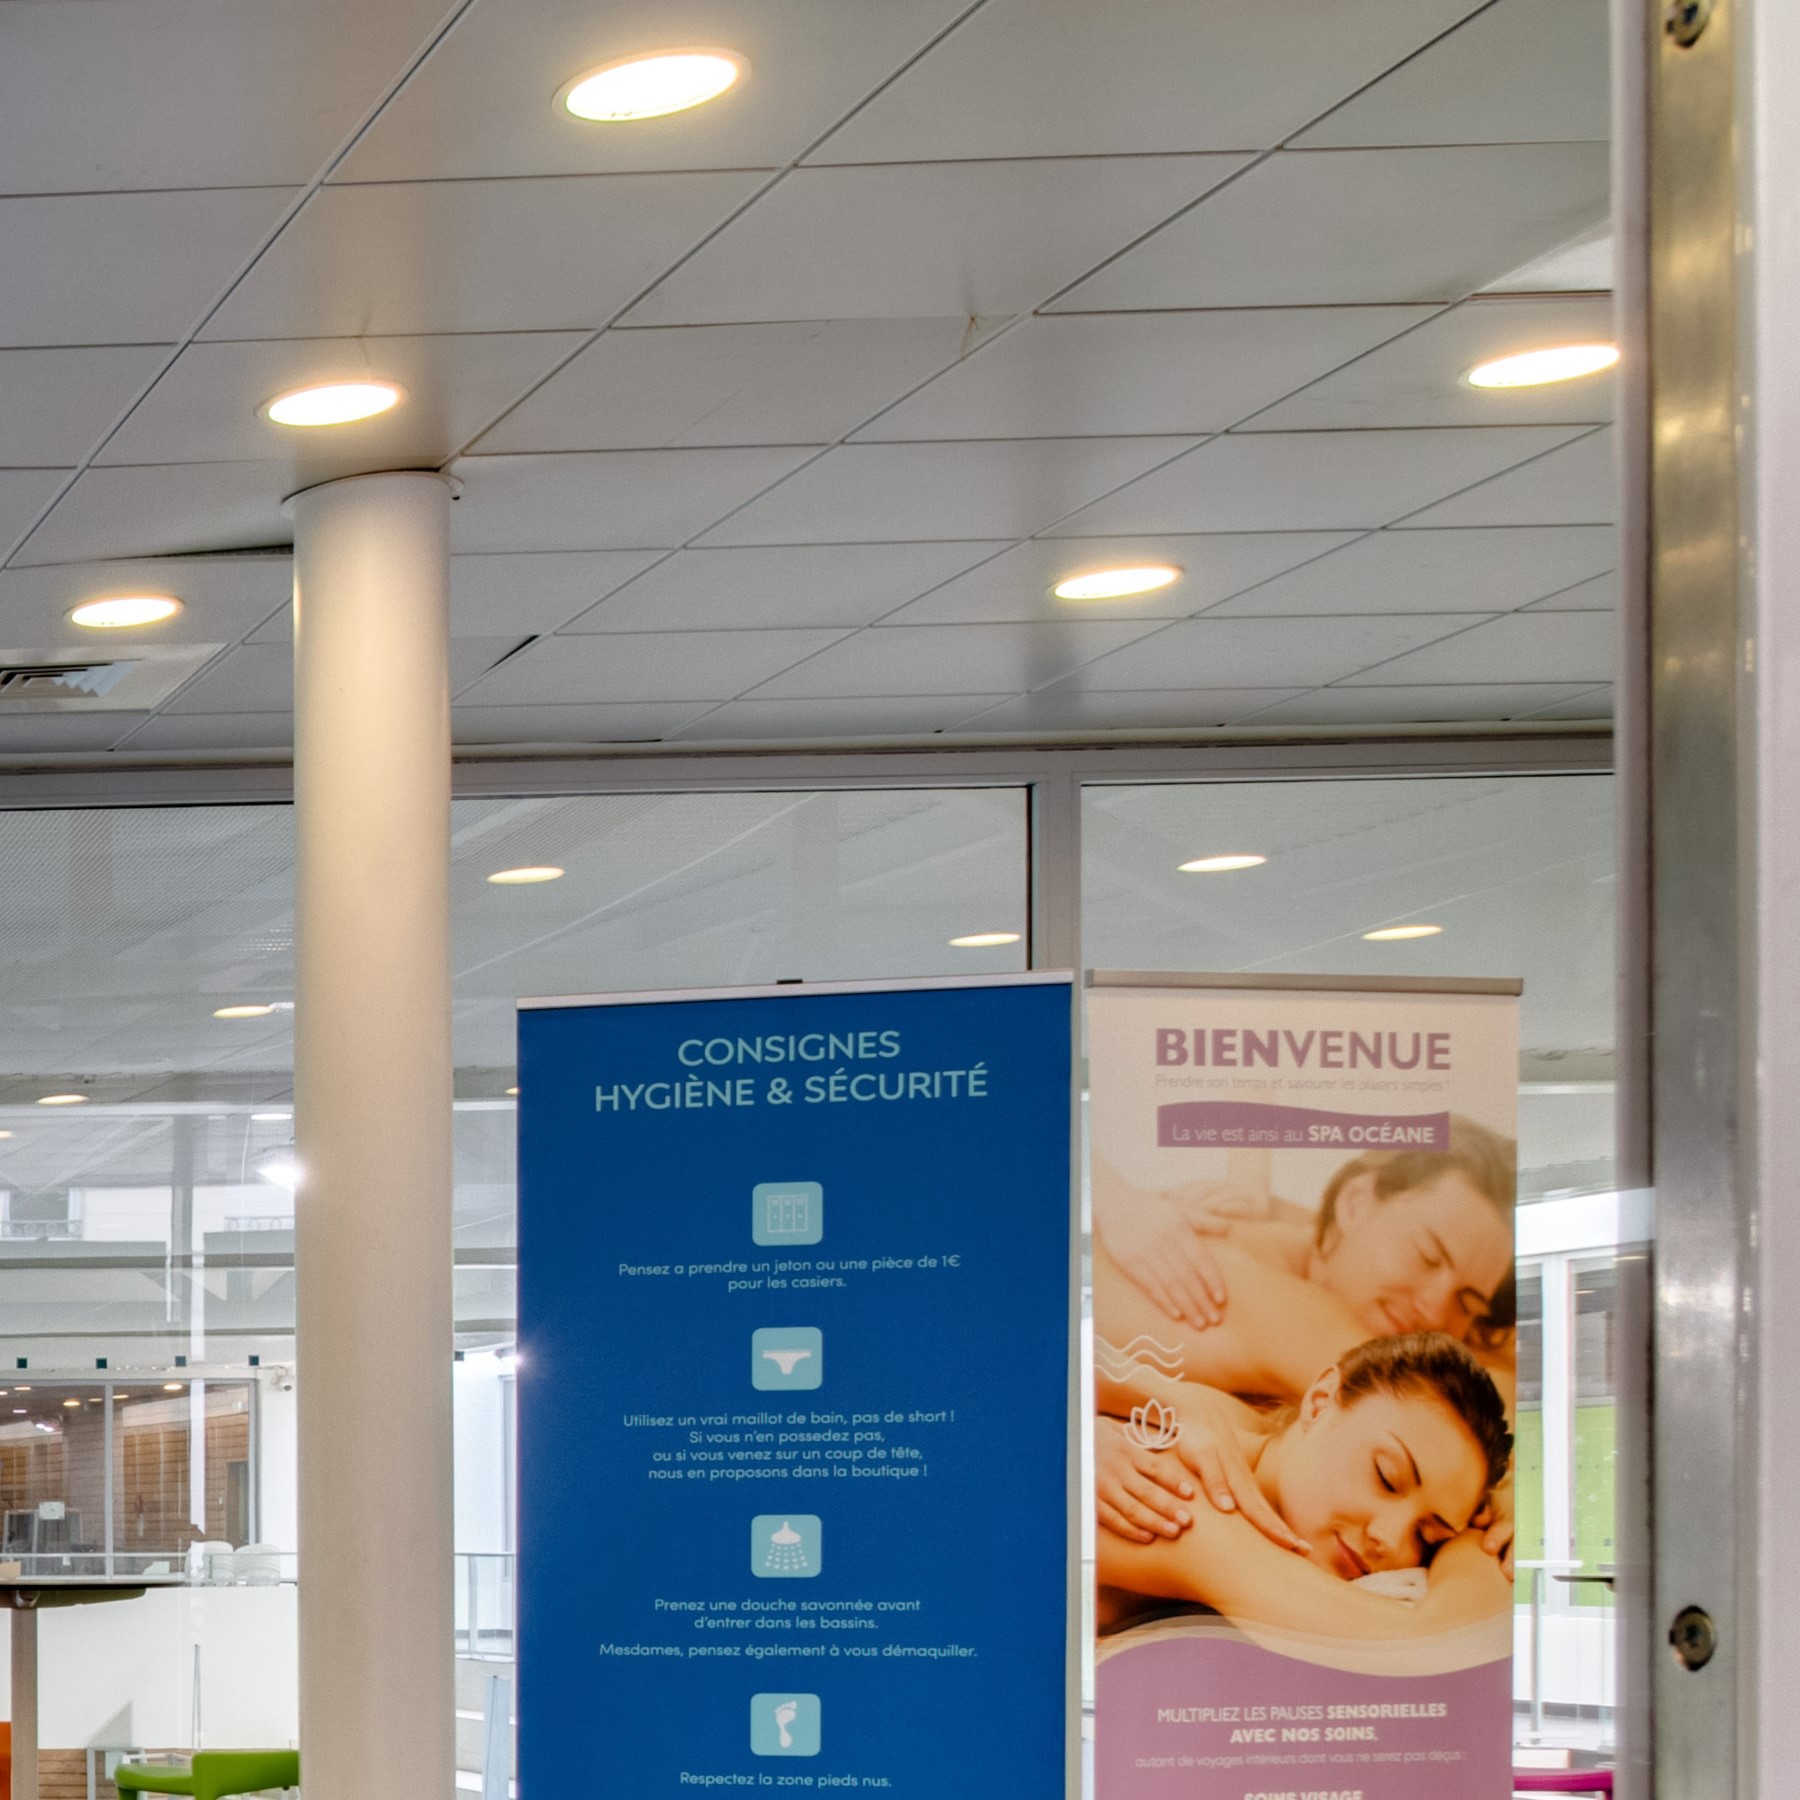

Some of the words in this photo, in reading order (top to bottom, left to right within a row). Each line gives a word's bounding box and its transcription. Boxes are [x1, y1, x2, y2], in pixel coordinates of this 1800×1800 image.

[678, 1030, 900, 1065] CONSIGNES
[1157, 1028, 1450, 1071] BIENVENUE
[596, 1074, 754, 1111] HYGIÈNE
[767, 1077, 792, 1104] &
[804, 1061, 987, 1102] SÉCURITÉ
[1308, 1125, 1343, 1141] SPA
[1349, 1122, 1433, 1143] OCÉANE
[619, 1263, 669, 1275] Pensez
[688, 1260, 747, 1276] prendre
[752, 1263, 769, 1272] un
[773, 1259, 811, 1274] jeton
[815, 1261, 834, 1270] ou
[839, 1260, 867, 1269] une
[872, 1256, 913, 1271] pièce
[917, 1255, 937, 1267] de
[942, 1254, 959, 1267] 1€
[728, 1280, 763, 1292] pour
[767, 1276, 787, 1288] les
[791, 1275, 846, 1288] casiers.
[624, 1414, 673, 1426] Utilisez
[678, 1416, 696, 1425] un
[700, 1413, 727, 1425] vrai
[732, 1412, 782, 1424] maillot
[786, 1412, 806, 1424] de
[810, 1411, 847, 1424] bain,
[852, 1414, 879, 1425] pas
[884, 1410, 904, 1422] de
[908, 1410, 946, 1422] short
[689, 1431, 702, 1443] Si
[706, 1433, 740, 1442] vous
[744, 1430, 773, 1442] n'en
[854, 1431, 884, 1443] pas,
[652, 1452, 671, 1461] ou
[676, 1449, 686, 1461] si
[690, 1451, 723, 1460] vous
[728, 1451, 771, 1460] venez
[776, 1450, 798, 1459] sur
[802, 1450, 820, 1459] un
[824, 1449, 862, 1462] coup
[866, 1446, 886, 1458] de
[891, 1446, 922, 1459] tête,
[648, 1470, 683, 1478] nous
[687, 1469, 705, 1478] en
[710, 1468, 788, 1481] proposons
[792, 1465, 828, 1477] dans
[833, 1464, 847, 1476] la
[852, 1465, 919, 1479] boutique
[655, 1599, 704, 1610] Prenez
[709, 1602, 736, 1610] une
[741, 1598, 796, 1610] douche
[801, 1599, 873, 1610] savonnée
[877, 1599, 920, 1611] avant
[694, 1616, 751, 1628] d'entrer
[755, 1616, 791, 1628] dans
[796, 1616, 815, 1628] les
[820, 1616, 878, 1628] bassins.
[600, 1643, 683, 1656] Mesdames,
[688, 1647, 740, 1658] pensez
[745, 1643, 825, 1659] également
[829, 1644, 839, 1656] à
[843, 1647, 878, 1656] vous
[882, 1644, 977, 1659] démaquiller.
[1158, 1707, 1239, 1722] MULTIPLIEZ
[1244, 1707, 1265, 1720] LES
[1271, 1706, 1322, 1719] PAUSES
[1327, 1703, 1445, 1718] SENSORIELLES
[1230, 1728, 1275, 1742] AVEC
[1282, 1728, 1319, 1741] NOS
[680, 1772, 754, 1787] Respectez
[759, 1773, 772, 1785] la
[777, 1776, 813, 1785] zone
[818, 1774, 858, 1788] pieds
[862, 1777, 891, 1786] nus.
